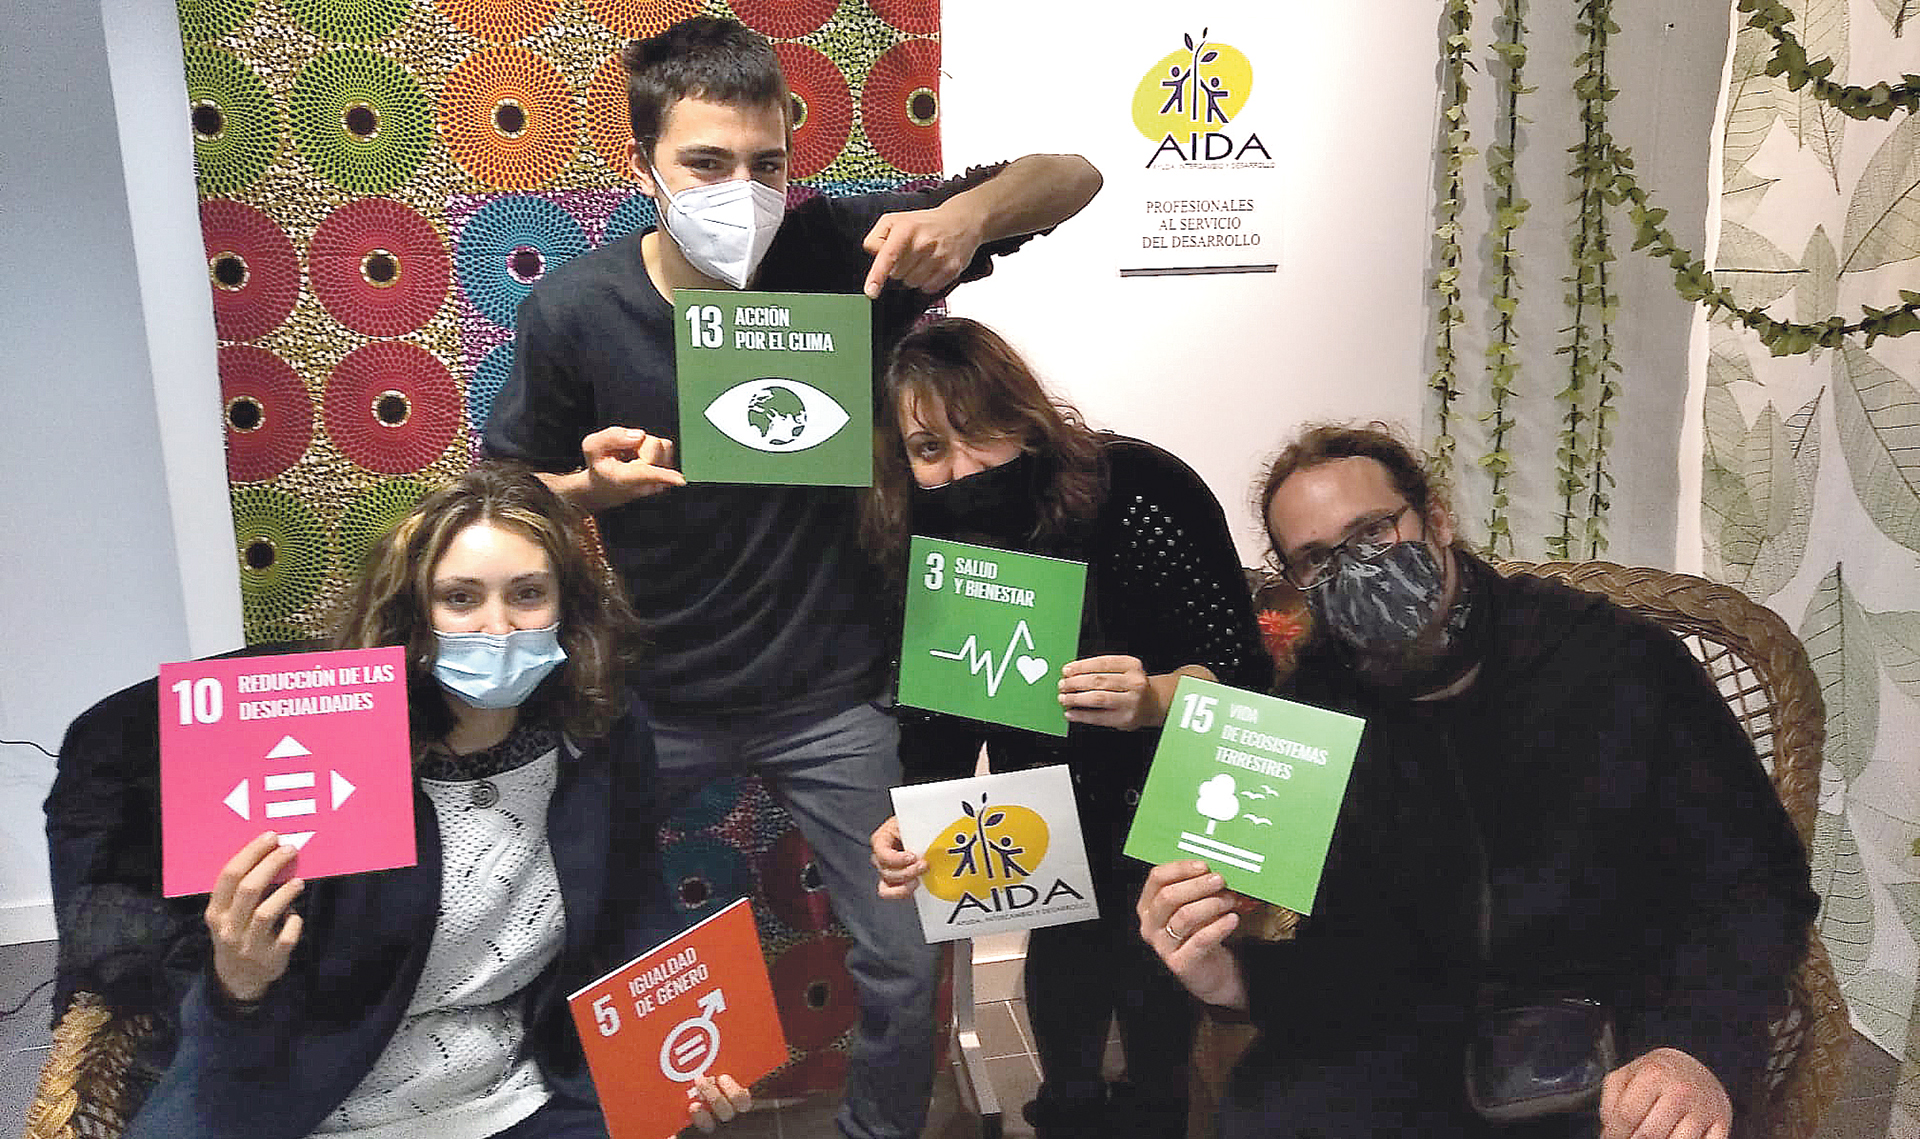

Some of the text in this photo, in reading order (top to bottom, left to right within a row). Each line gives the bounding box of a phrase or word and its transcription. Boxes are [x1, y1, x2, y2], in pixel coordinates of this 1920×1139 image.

[1145, 132, 1273, 168] AIDA
[1146, 199, 1255, 214] PROFESIONALES
[1158, 216, 1241, 231] AL SERVICIO
[1142, 233, 1261, 249] DEL DESARROLLO
[684, 305, 725, 349] 13
[734, 304, 790, 327] ACCIÓN
[735, 330, 835, 352] POR EL CLIMA
[924, 552, 945, 590] 3
[954, 556, 998, 580] SALUD
[953, 577, 1036, 608] Y BIENESTAR
[237, 664, 395, 694] REDUCCIÓN DE LAS
[171, 677, 224, 726] 10
[238, 692, 374, 721] DESIGUALDADES
[1179, 692, 1220, 735] 15
[1229, 702, 1259, 725] VIDA
[1220, 723, 1329, 766] DE ECOSISTEMAS
[1215, 745, 1293, 780] TERRESTRES
[947, 878, 1085, 925] AIDA
[628, 947, 698, 998] IGUALDAD
[592, 994, 621, 1037] 5
[634, 995, 656, 1018] DE
